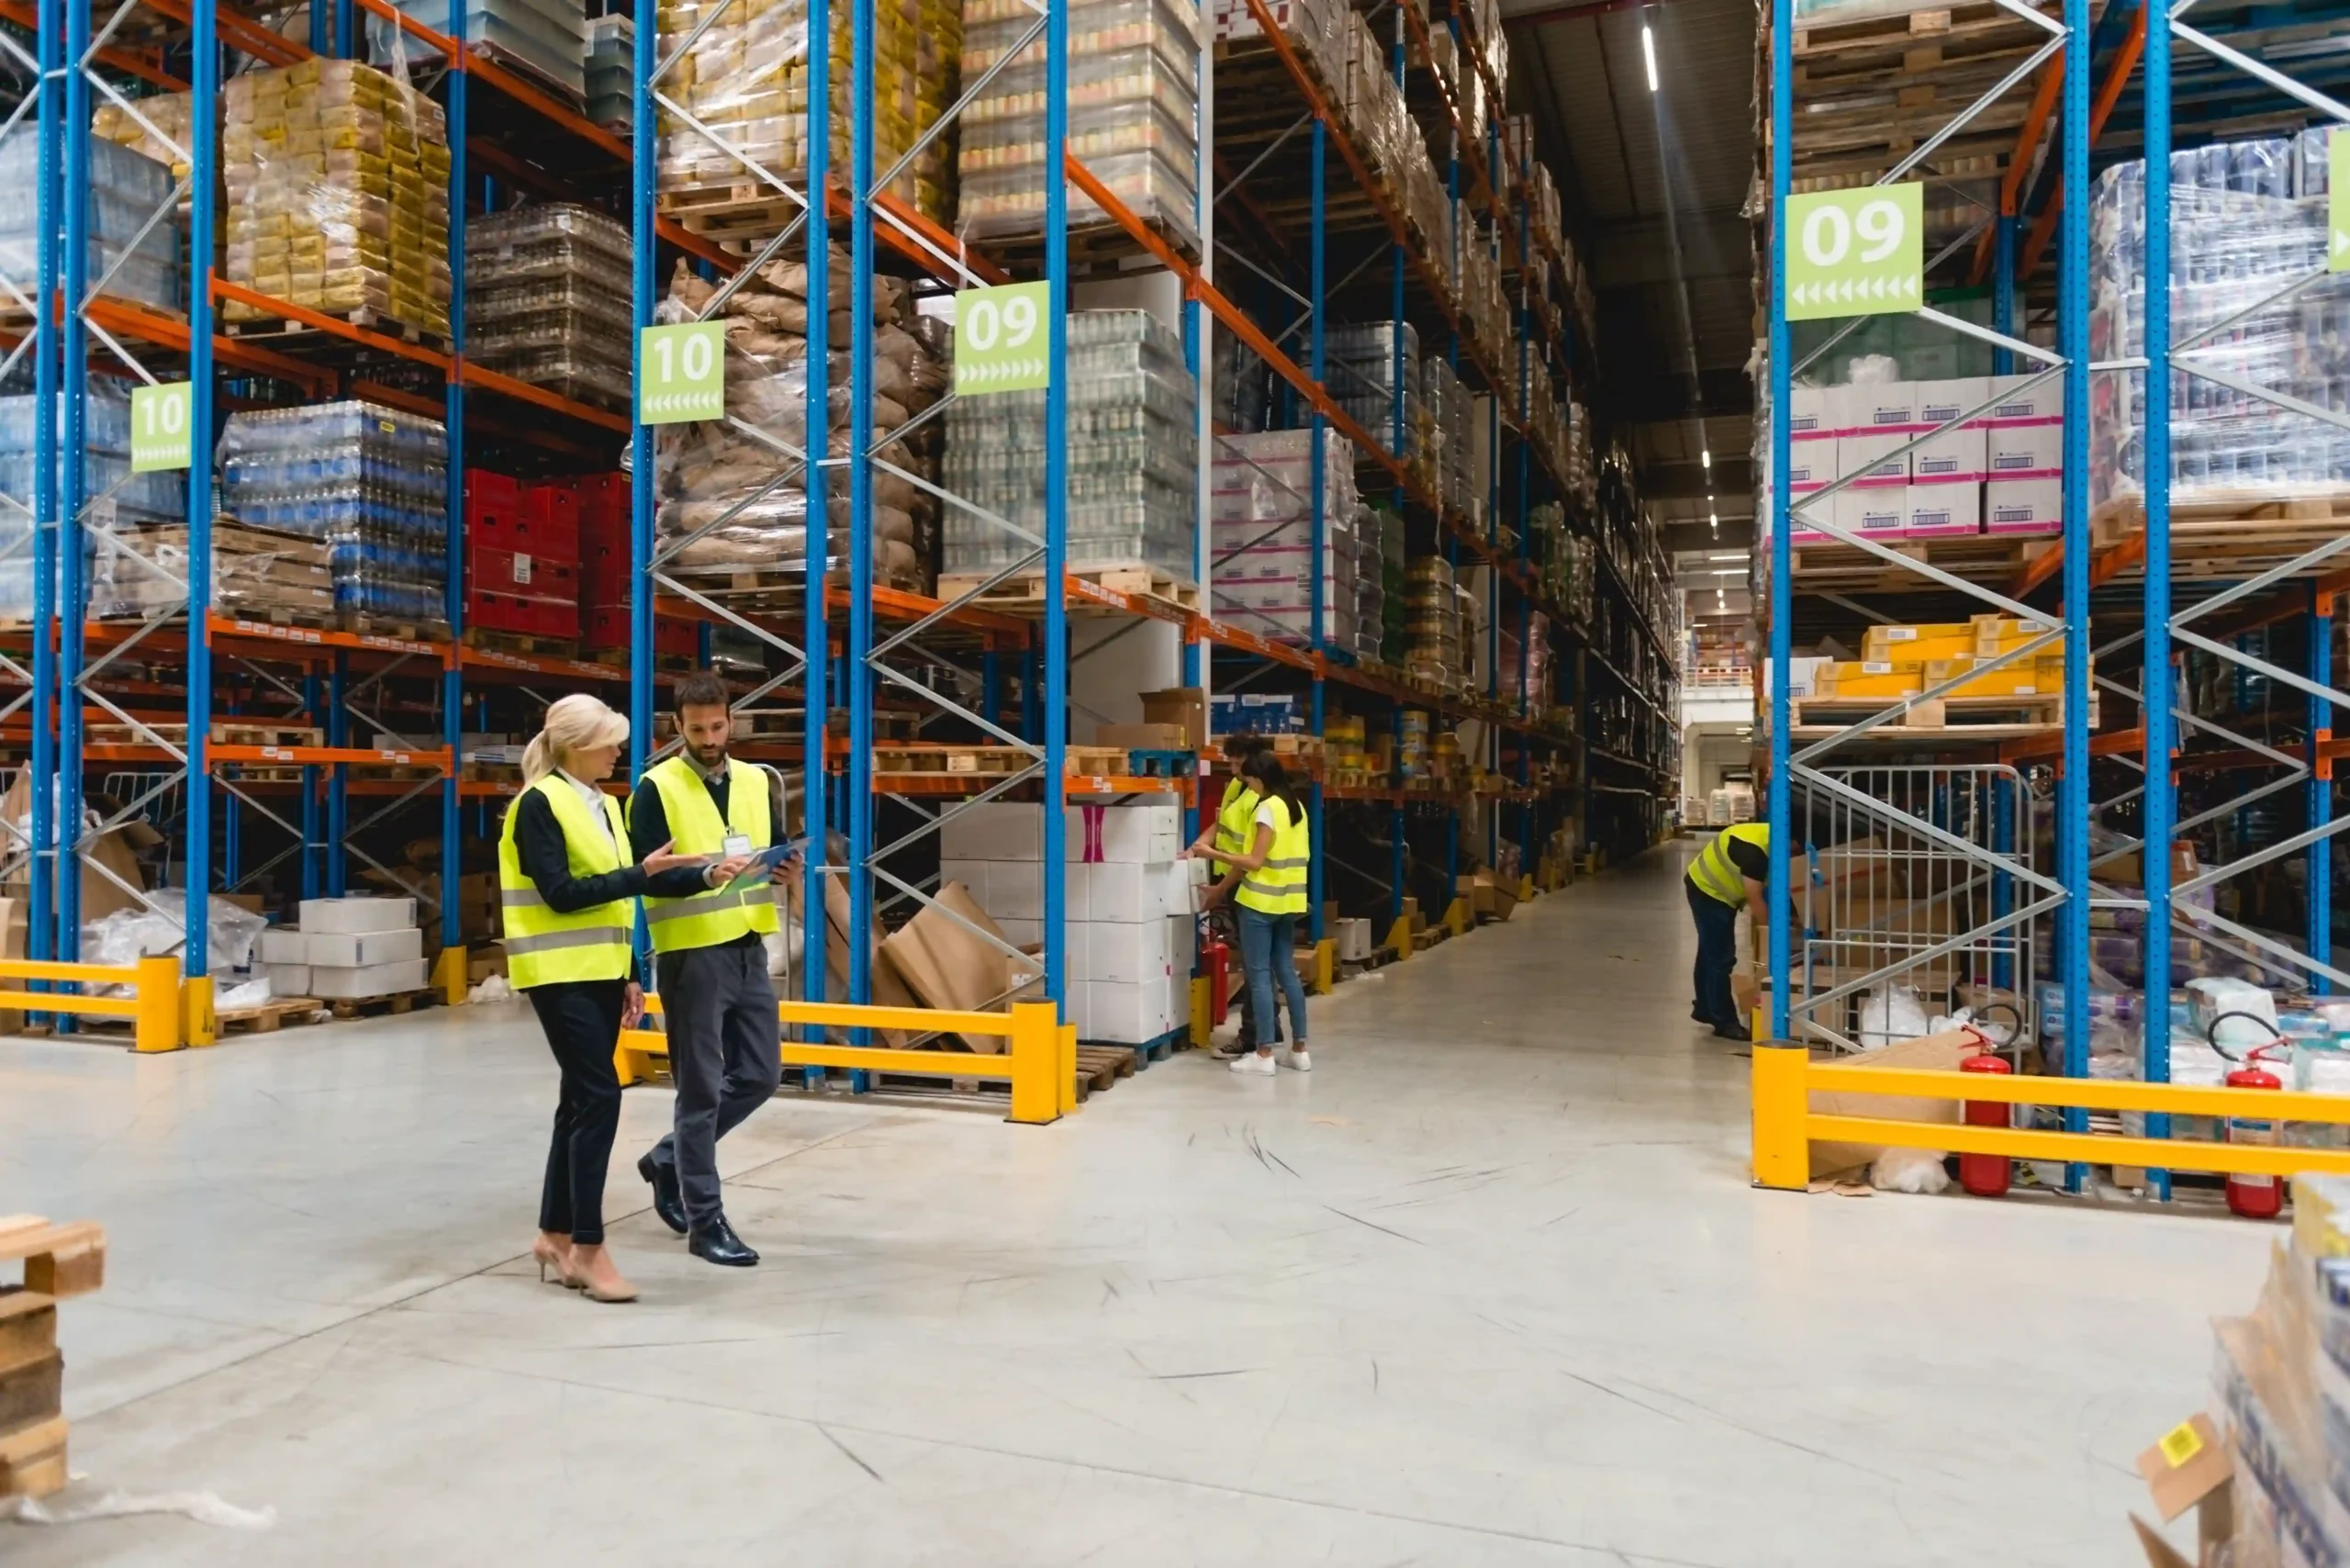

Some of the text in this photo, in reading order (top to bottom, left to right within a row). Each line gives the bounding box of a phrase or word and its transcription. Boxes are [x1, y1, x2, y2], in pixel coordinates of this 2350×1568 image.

[1803, 200, 1904, 266] 09
[967, 296, 1037, 351] 09
[654, 333, 712, 383] 10
[140, 393, 183, 435] 10
